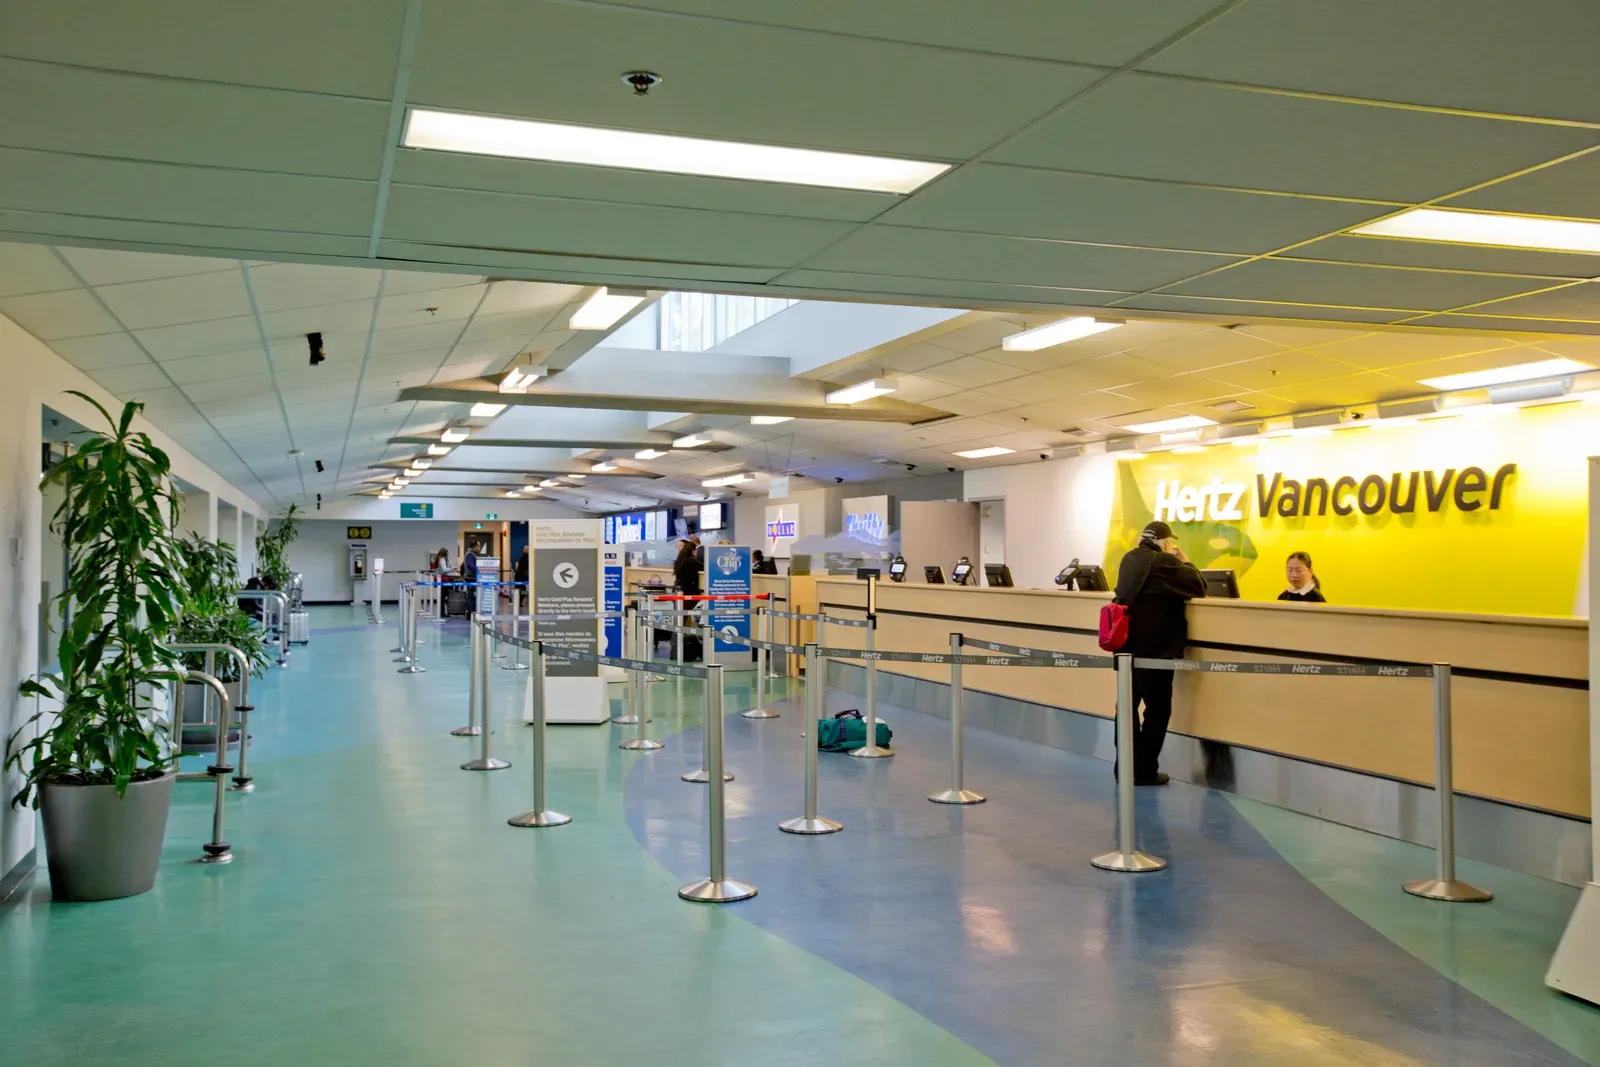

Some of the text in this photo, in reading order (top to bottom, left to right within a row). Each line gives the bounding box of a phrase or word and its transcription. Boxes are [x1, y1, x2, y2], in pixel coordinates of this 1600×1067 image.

[1154, 463, 1517, 522] Hertz Vancouver
[768, 523, 794, 537] DOLLAR
[860, 651, 1080, 667] Hertz Hertz Hertz Hertz
[631, 661, 645, 670] Hertz
[667, 665, 681, 675] Hertz
[1210, 662, 1409, 676] Hertz Hertz Hertz
